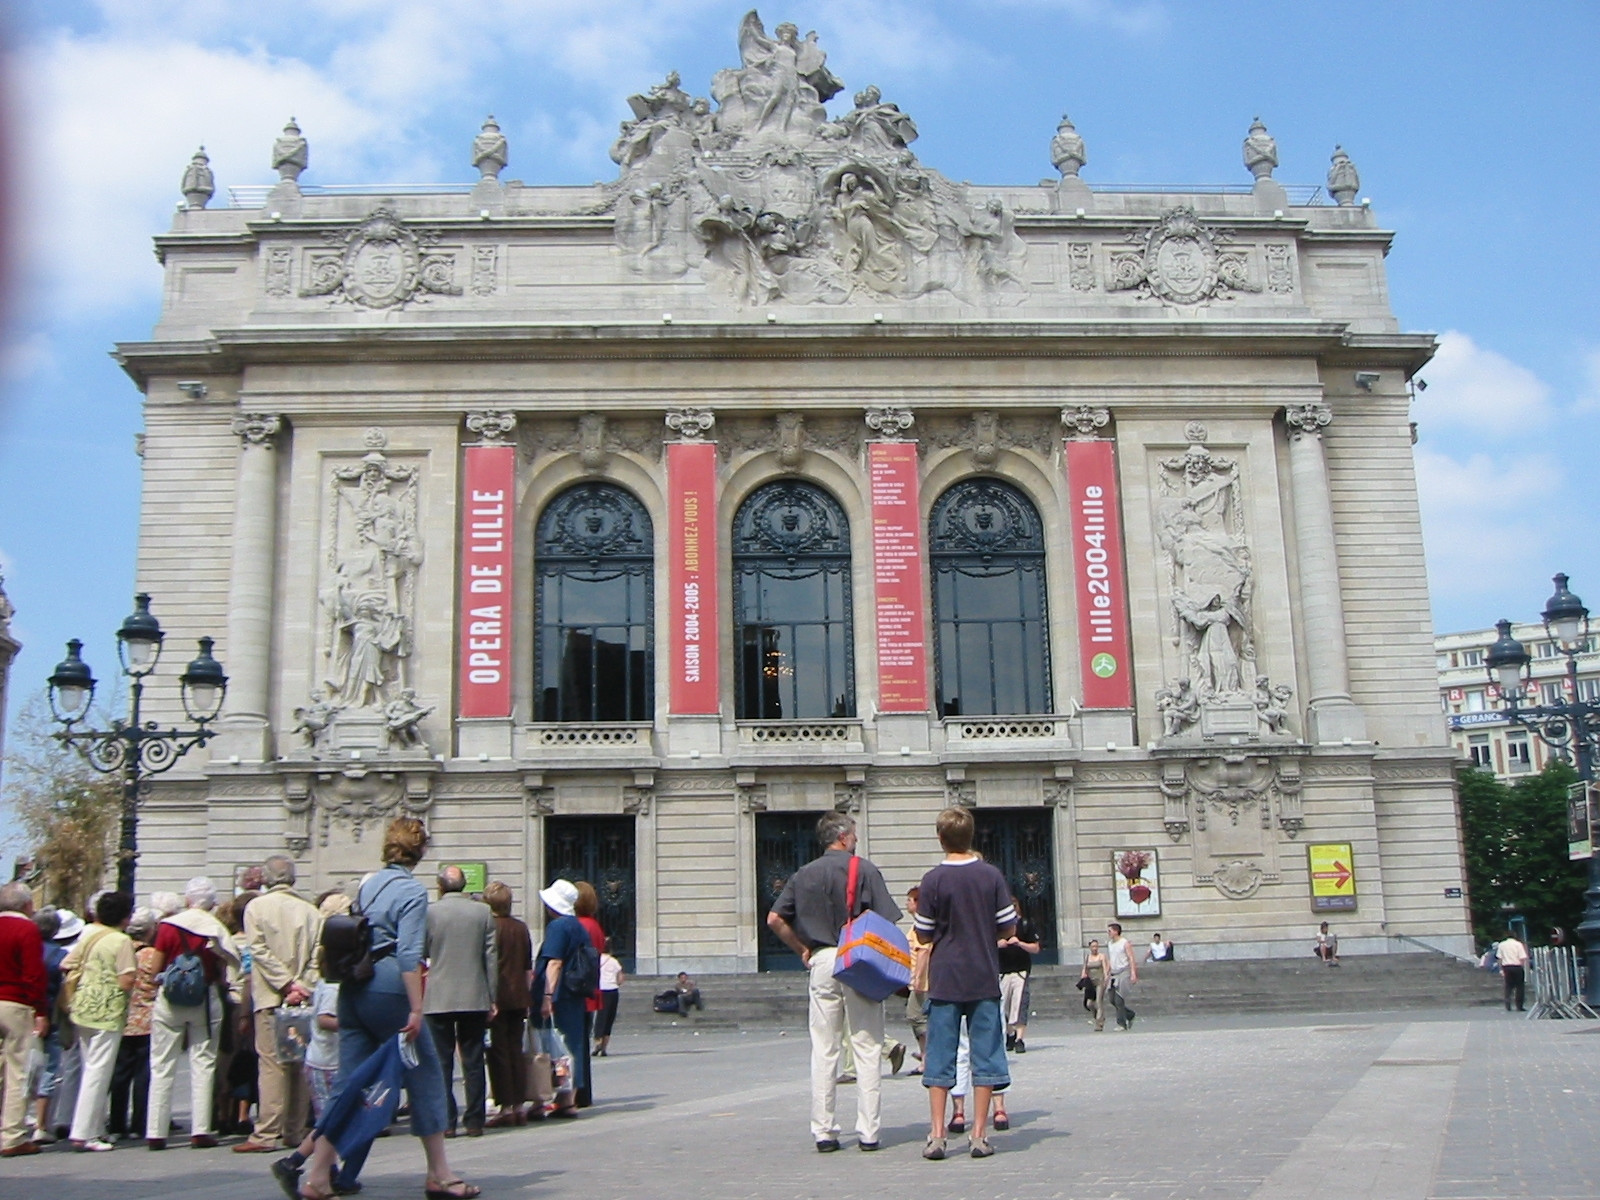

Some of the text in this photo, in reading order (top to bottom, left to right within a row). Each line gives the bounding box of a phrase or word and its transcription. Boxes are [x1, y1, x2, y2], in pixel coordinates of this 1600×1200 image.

[469, 490, 503, 684] OPERA DE LILLE
[685, 582, 700, 641] 2004-2005
[685, 644, 700, 682] SAISON
